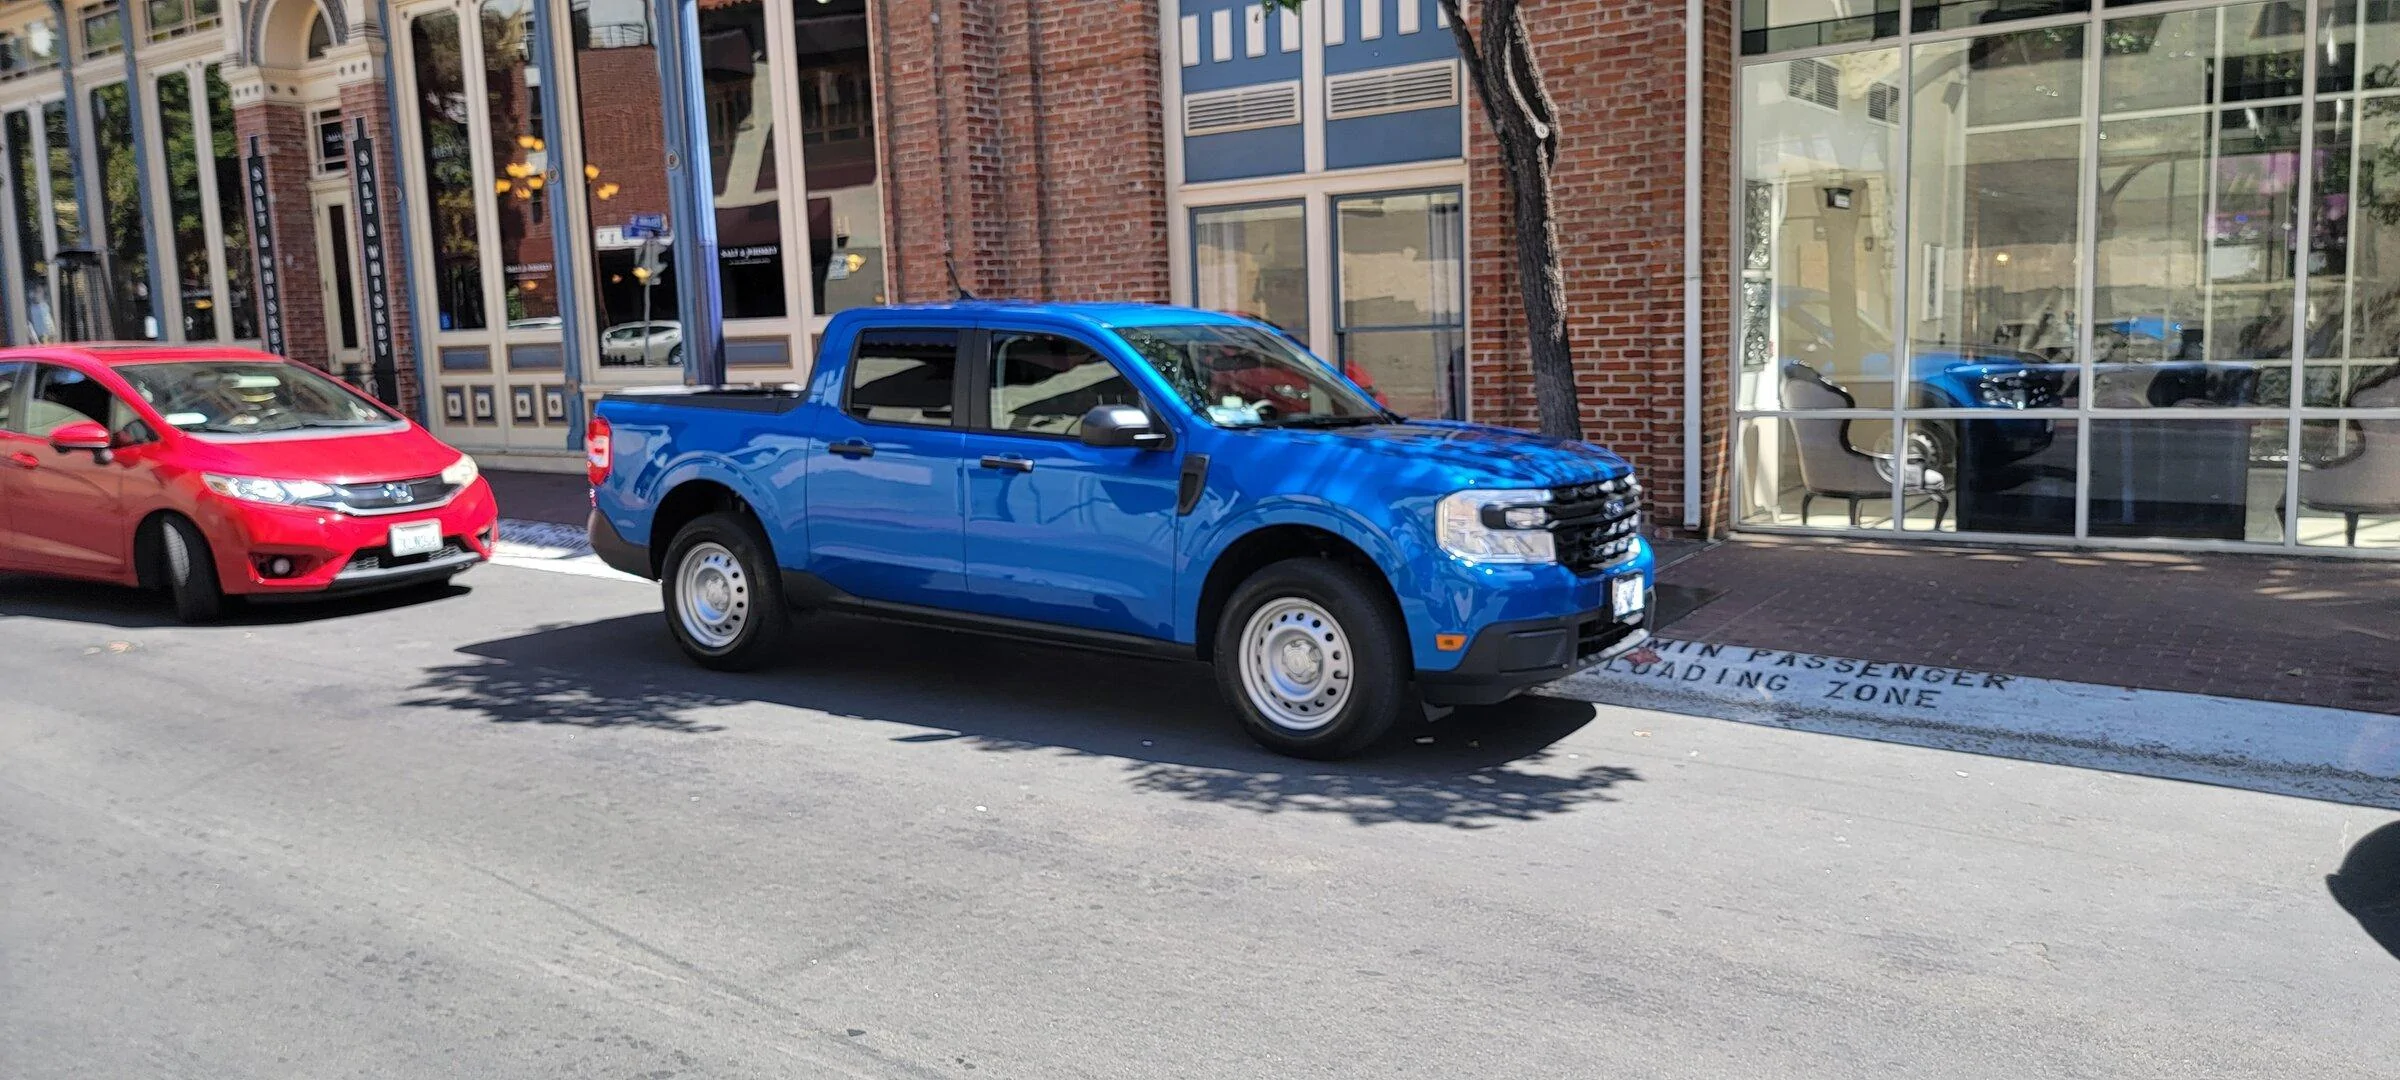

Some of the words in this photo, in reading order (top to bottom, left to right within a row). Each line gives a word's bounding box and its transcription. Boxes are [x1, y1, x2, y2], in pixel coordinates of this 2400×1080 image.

[251, 165, 267, 226] SALT
[358, 150, 374, 215] SALT
[259, 233, 270, 248] &
[366, 222, 377, 238] &
[261, 254, 281, 354] WHISKEY
[367, 244, 388, 356] WHISKEY
[1604, 655, 1790, 691] LOADING
[1824, 680, 1941, 709] ZONE
[1646, 638, 1724, 658] MIN
[1747, 650, 2015, 690] PASSENGER
